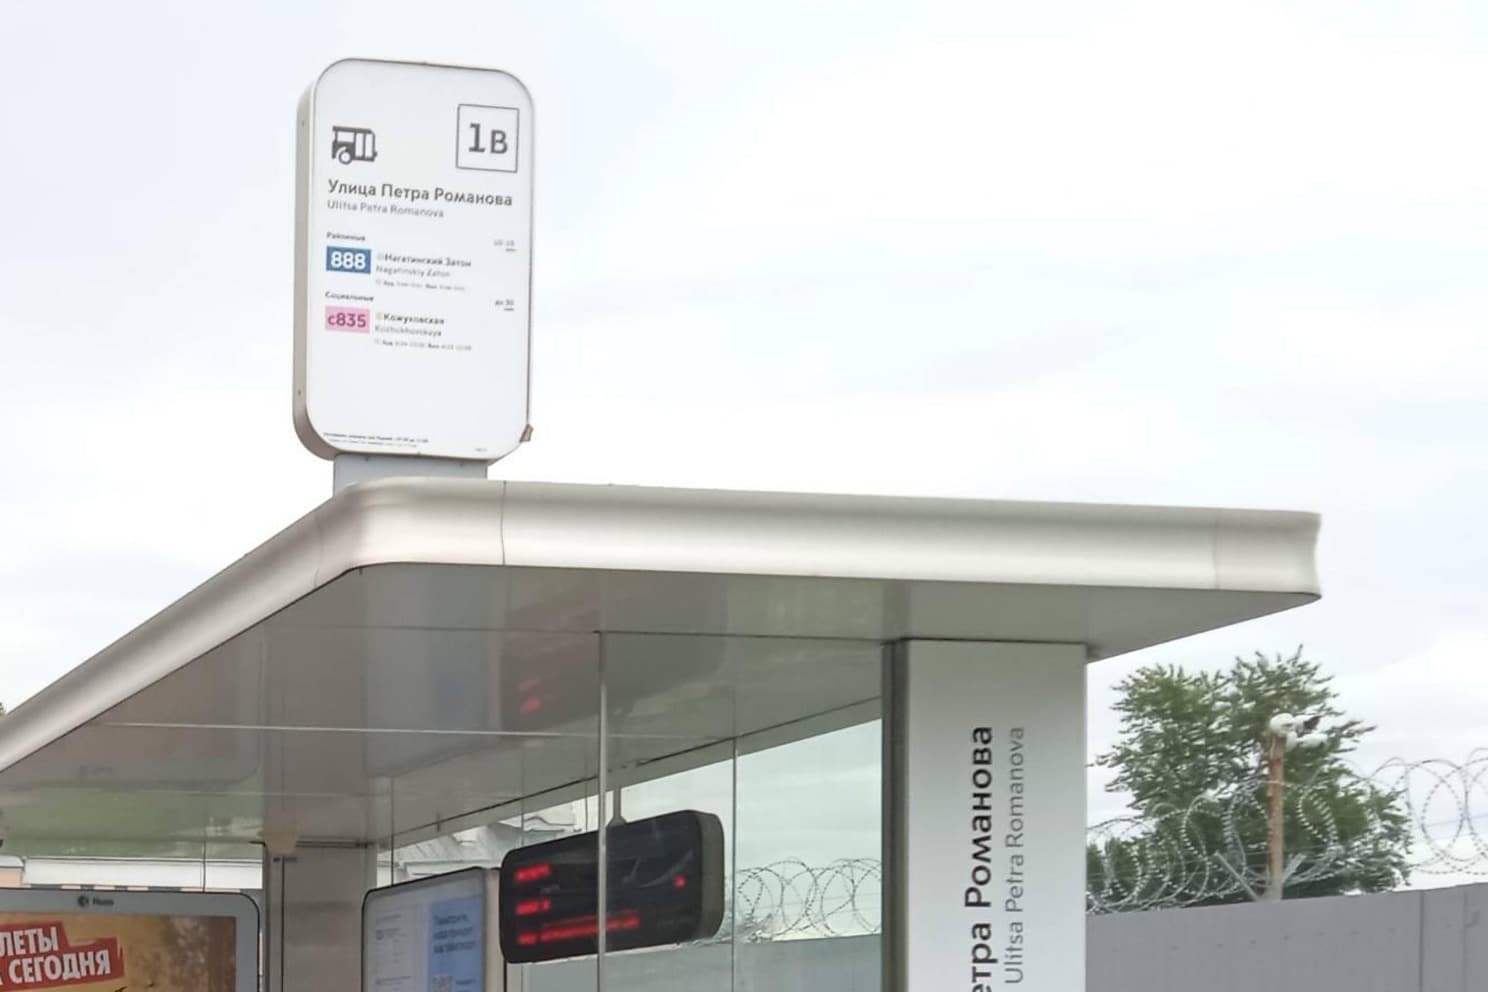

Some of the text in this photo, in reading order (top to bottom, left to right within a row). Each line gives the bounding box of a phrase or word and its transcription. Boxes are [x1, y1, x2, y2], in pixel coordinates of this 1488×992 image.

[468, 122, 509, 155] 1В
[327, 178, 513, 206] Улица Петра Романова
[327, 199, 444, 218] Ulitsa Petra Romanova
[330, 250, 367, 271] 888
[964, 726, 993, 908] Романова
[1003, 727, 1025, 984] Ulitsa Petra Romanova
[8, 949, 112, 984] СЕГОДНЯ
